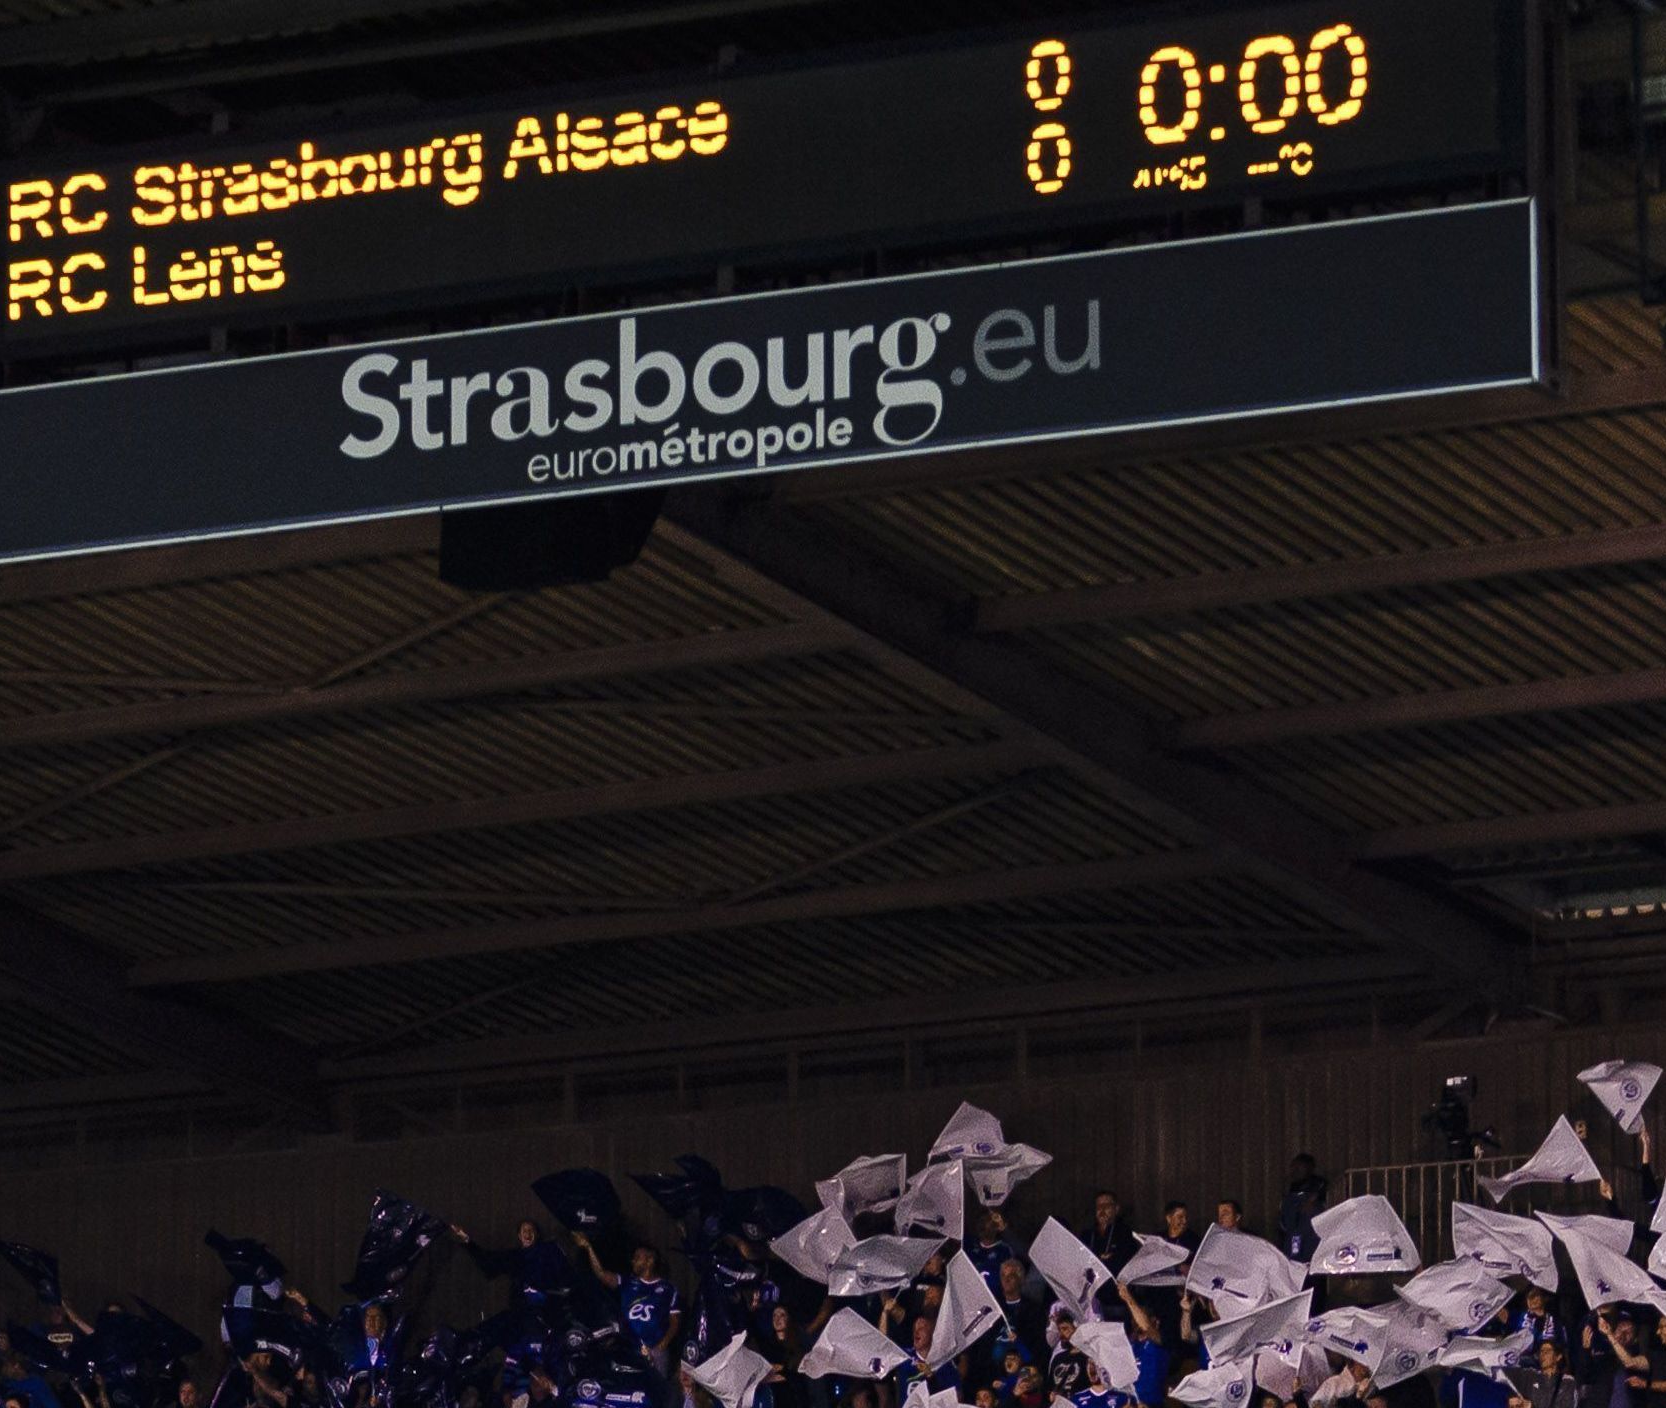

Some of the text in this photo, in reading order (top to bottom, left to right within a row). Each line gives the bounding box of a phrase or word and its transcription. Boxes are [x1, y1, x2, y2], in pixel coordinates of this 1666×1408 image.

[1026, 40, 1071, 110] 0
[1139, 24, 1367, 145] 0:00
[9, 101, 730, 241] RC Strasbourg Alsace
[1026, 123, 1071, 193] 0
[8, 240, 286, 321] RC Lens
[339, 298, 1102, 460] Strasbourg.eu
[526, 408, 853, 484] eurométropole
